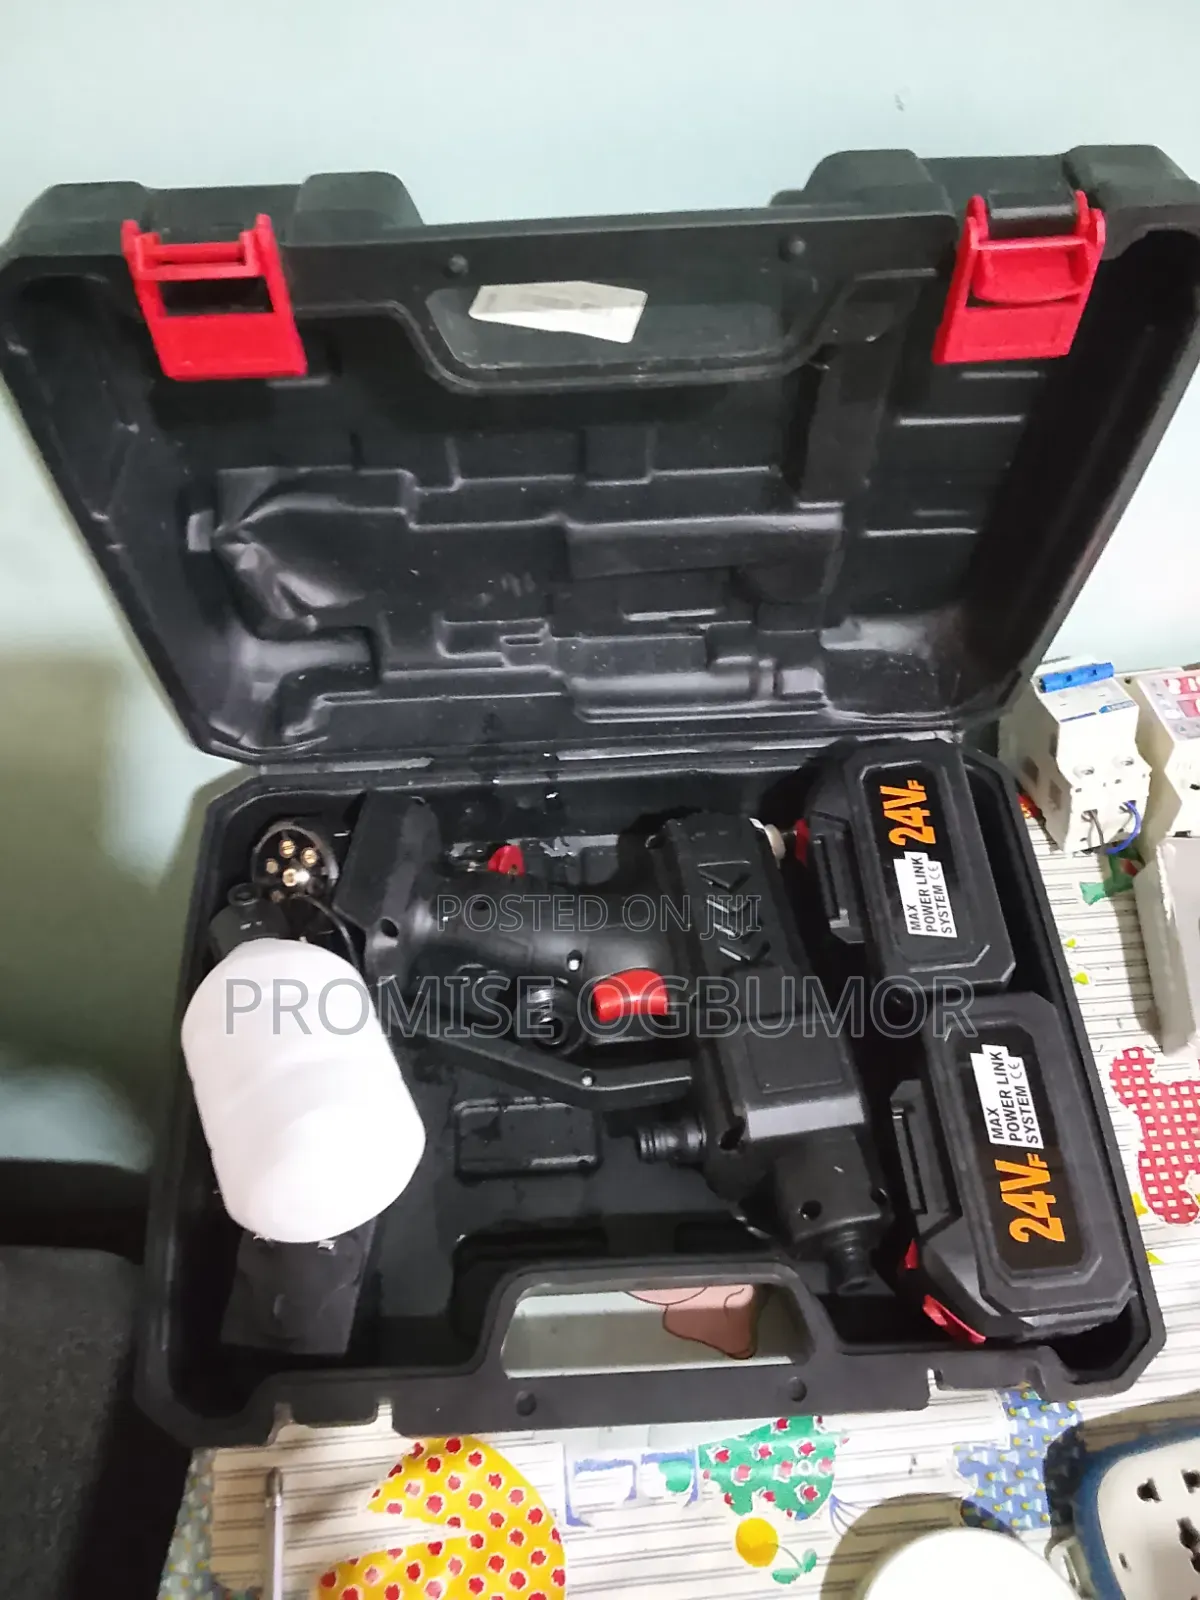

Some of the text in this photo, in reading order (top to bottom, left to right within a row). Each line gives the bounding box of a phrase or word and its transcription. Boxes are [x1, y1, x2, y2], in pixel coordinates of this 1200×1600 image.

[906, 904, 922, 931] MAX
[913, 857, 938, 933] POWER LINK
[932, 885, 952, 934] SYSTEM
[986, 1107, 1004, 1139] MAX
[989, 1051, 1022, 1142] POWER LINK
[1016, 1085, 1038, 1144] SYSTEM
